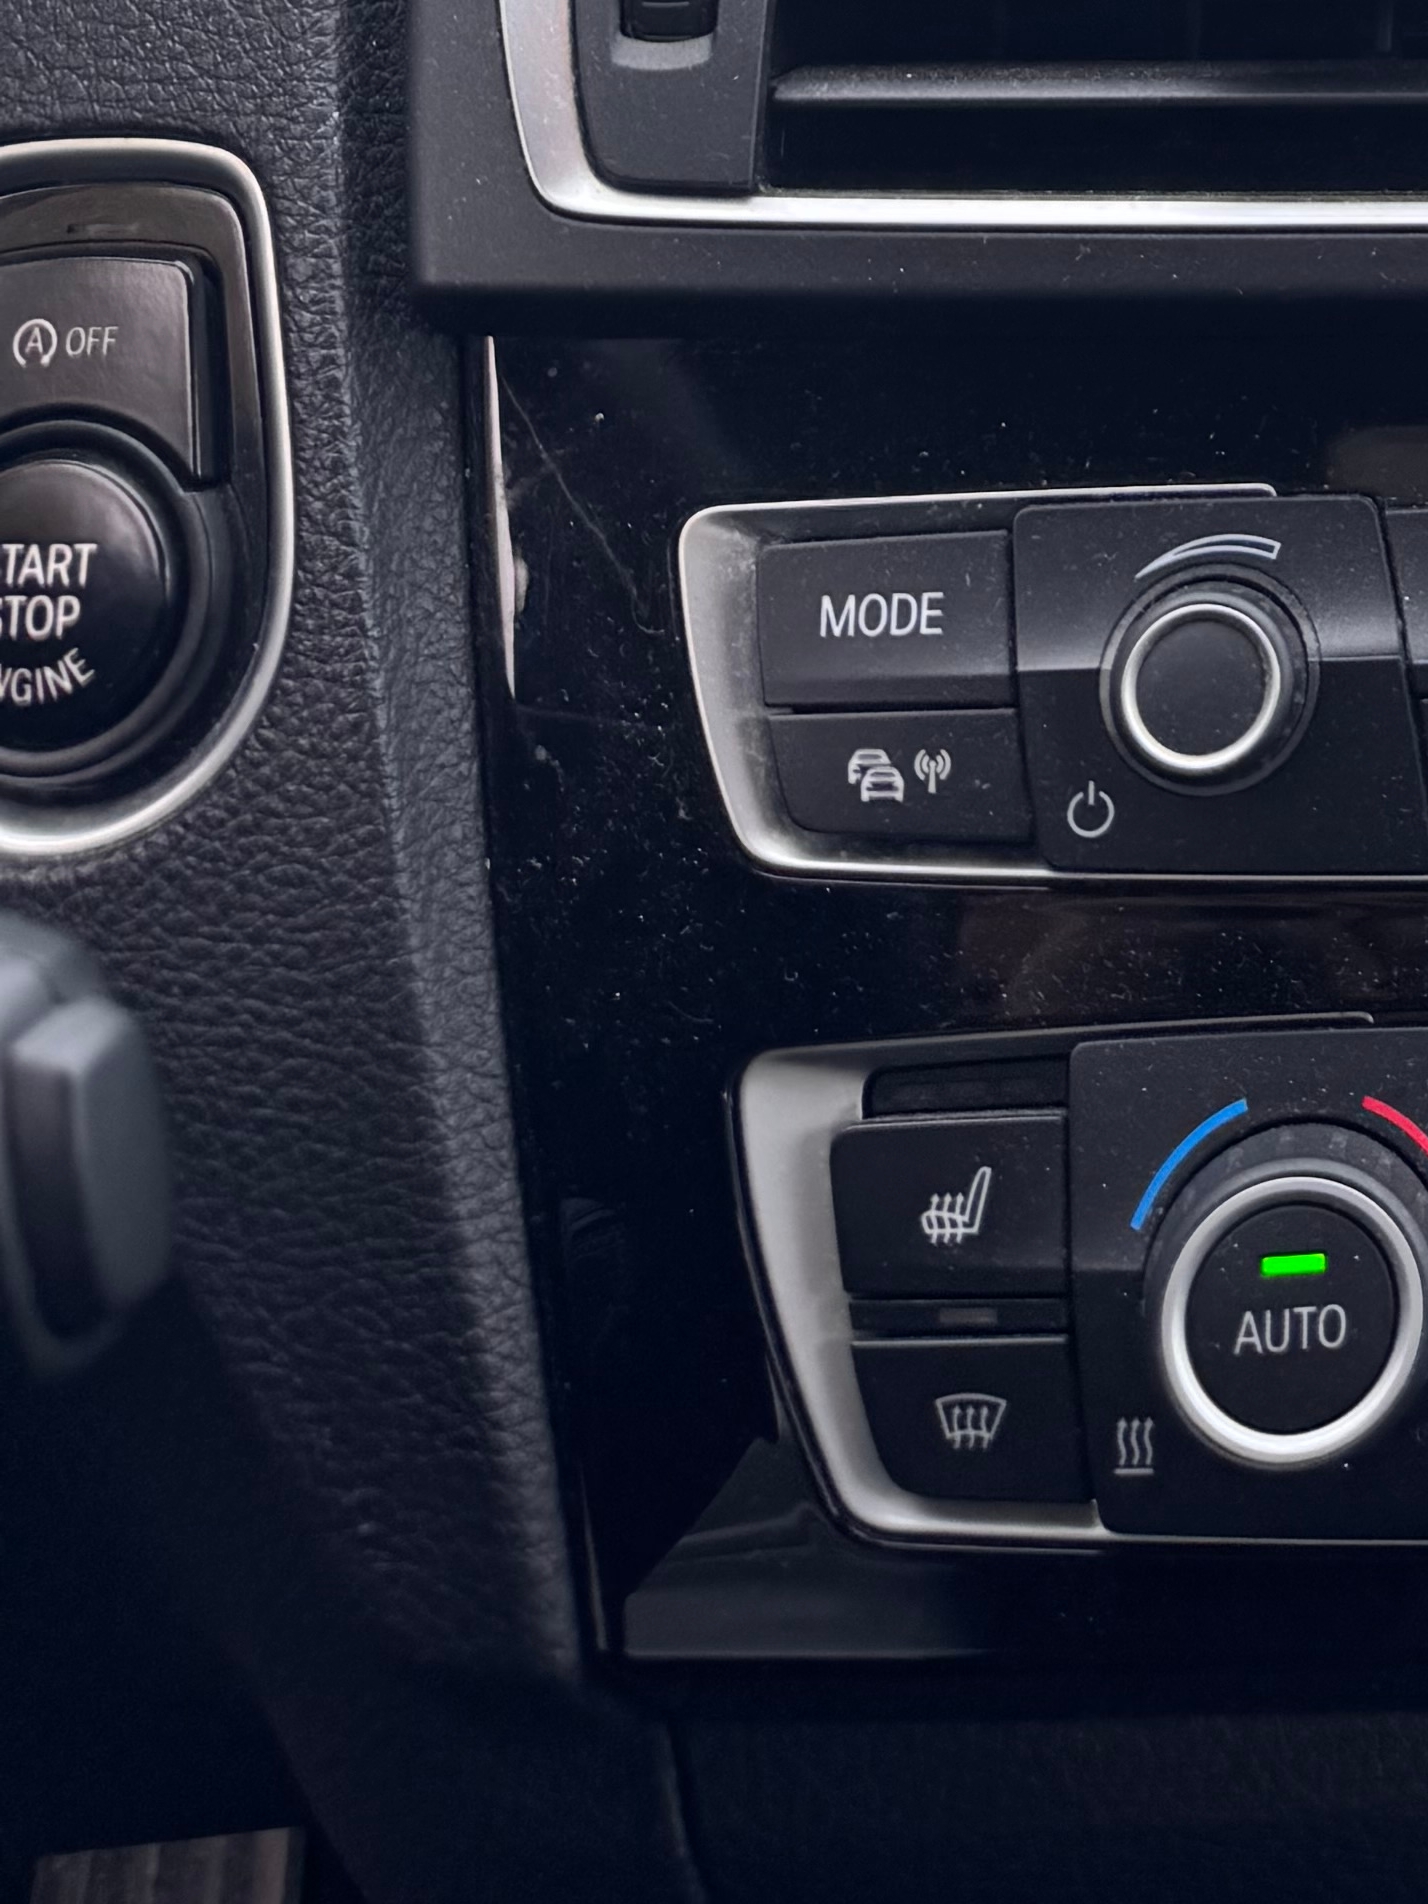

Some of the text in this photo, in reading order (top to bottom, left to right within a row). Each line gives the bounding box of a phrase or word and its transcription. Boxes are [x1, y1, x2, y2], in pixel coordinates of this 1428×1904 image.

[24, 326, 119, 356] A OFF
[0, 543, 98, 587] TART
[0, 595, 81, 640] TOP
[820, 592, 943, 637] MODE
[0, 648, 95, 706] GINE
[1235, 1304, 1346, 1354] AUTO
